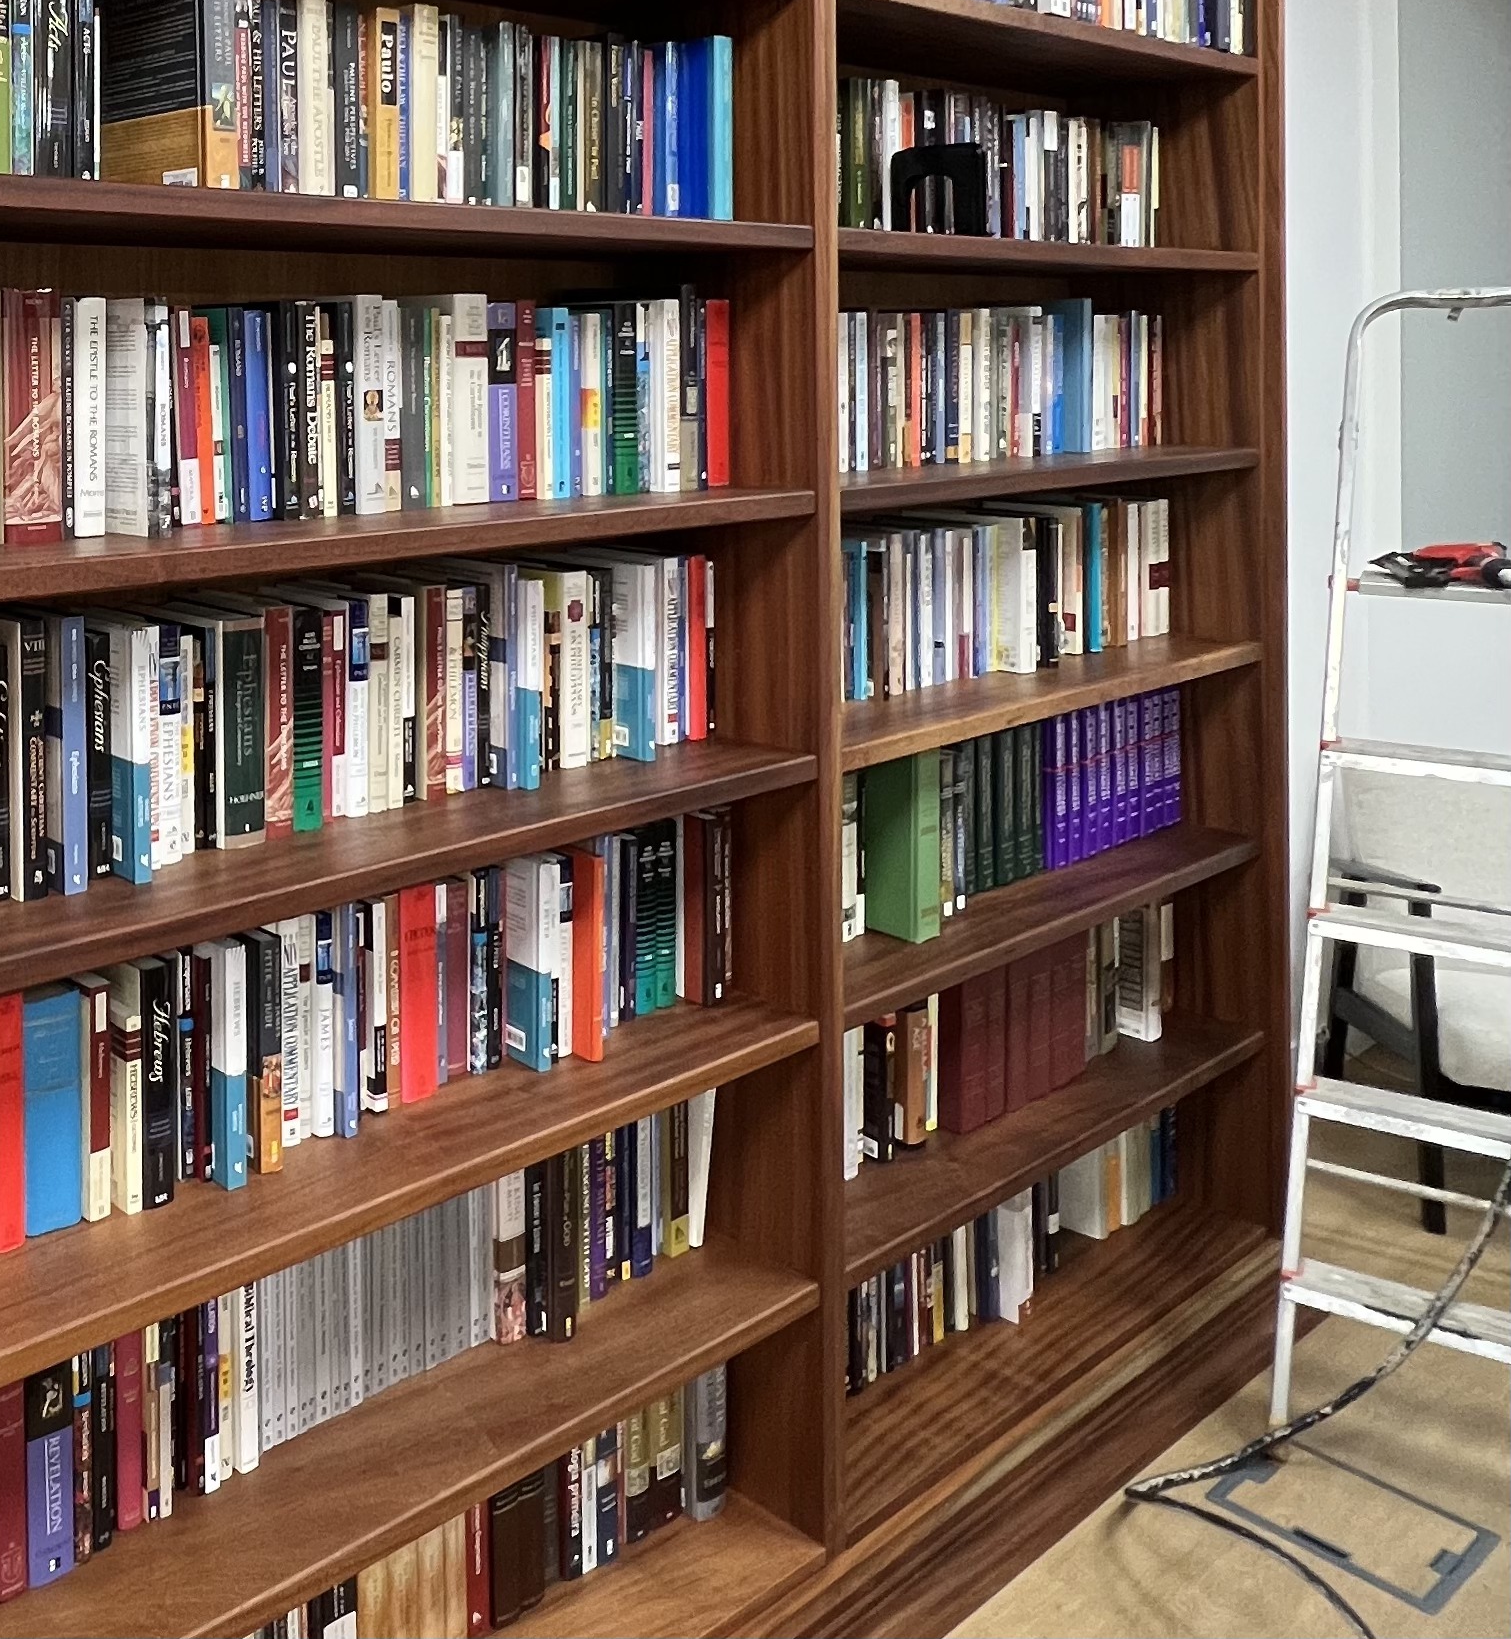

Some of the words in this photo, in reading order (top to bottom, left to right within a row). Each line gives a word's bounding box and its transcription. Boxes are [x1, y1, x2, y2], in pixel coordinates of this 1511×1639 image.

[48, 2, 70, 53] Acts
[252, 29, 261, 41] &
[252, 44, 261, 73] HIS
[282, 30, 296, 96] PAUL
[381, 33, 394, 94] Paulo
[252, 75, 261, 131] LETTERS
[305, 314, 315, 343] The
[90, 341, 98, 381] EPISTLE
[305, 344, 317, 409] Romans
[90, 386, 97, 400] TO
[386, 361, 396, 433] ROMANS
[90, 430, 98, 482] ROMANS
[306, 412, 317, 465] Debate
[23, 639, 46, 651] VIII
[88, 660, 111, 754] Ephesians
[138, 665, 146, 732] EPHESIANS
[237, 654, 258, 757] Ephesians
[163, 721, 173, 802] EPHESIANS
[232, 980, 240, 1038] HEBREWS
[283, 967, 298, 1036] APPLICATION
[321, 1008, 329, 1052] JAMES
[149, 1000, 170, 1082] Hebrews
[283, 1038, 299, 1105] COMMENTARY
[244, 1335, 255, 1392] Theology
[48, 1435, 62, 1534] REVELATION
